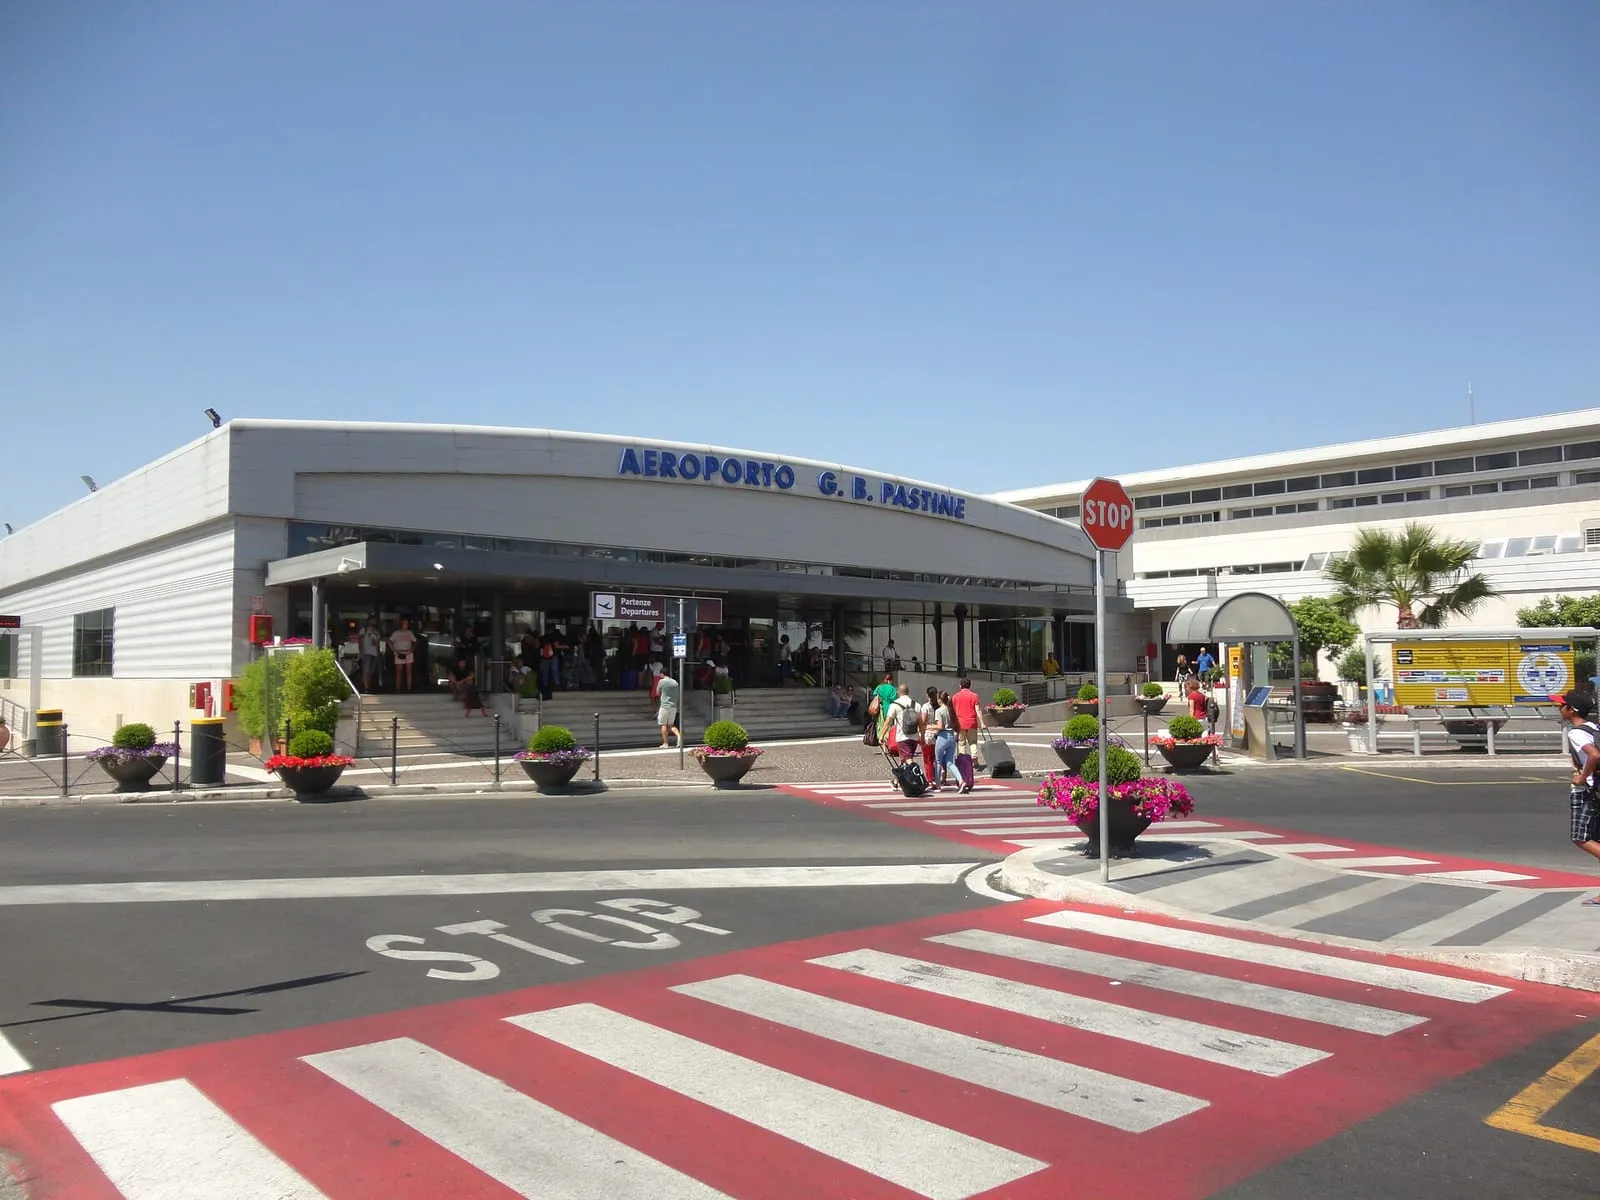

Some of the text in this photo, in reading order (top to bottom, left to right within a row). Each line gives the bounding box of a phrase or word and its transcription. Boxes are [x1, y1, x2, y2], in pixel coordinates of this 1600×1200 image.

[619, 447, 966, 519] AEROPORTO G. B. PASTINE
[1085, 499, 1131, 530] STOP
[620, 597, 652, 607] Partenze
[620, 607, 659, 617] Departures
[365, 897, 734, 982] STOP
